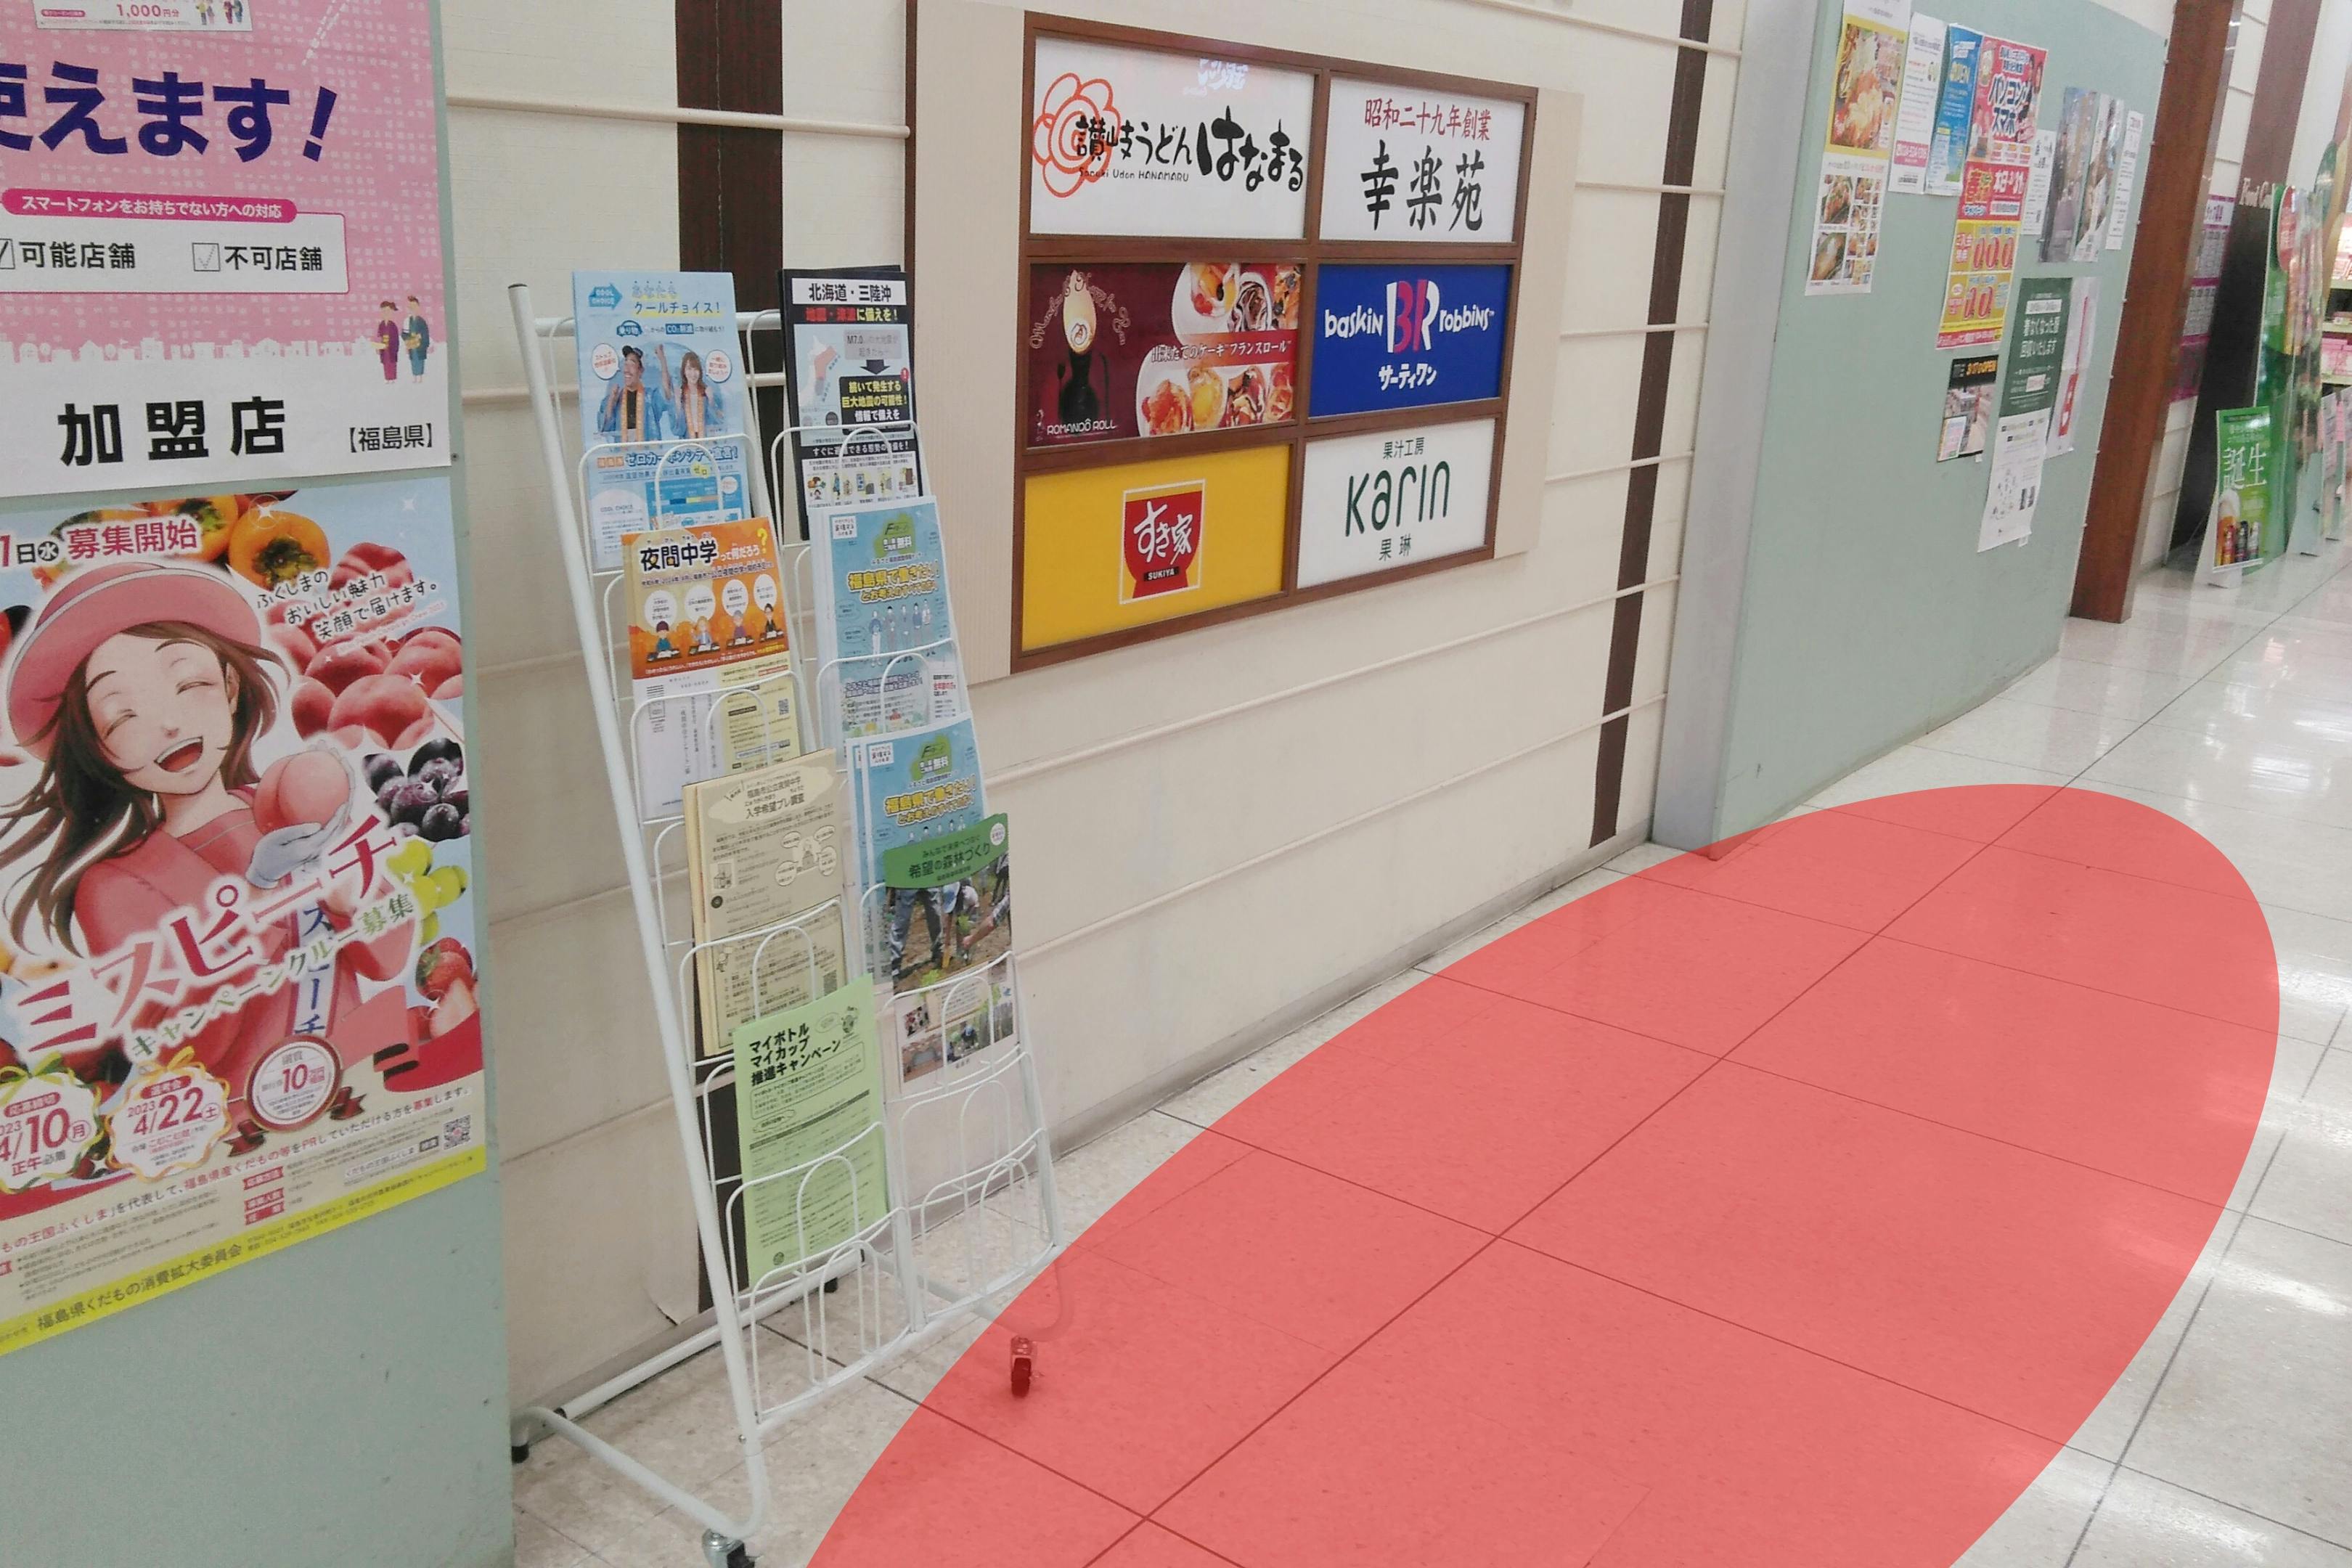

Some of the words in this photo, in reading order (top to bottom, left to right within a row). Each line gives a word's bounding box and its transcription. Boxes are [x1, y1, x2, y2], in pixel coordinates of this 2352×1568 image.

[1365, 97, 1493, 142] 昭和二十九年創業
[1075, 115, 1193, 166] 讃岐うどん
[1196, 105, 1304, 192] はなまる
[1112, 168, 1135, 179] Udon
[1138, 171, 1189, 181] HANAMARU
[1360, 139, 1485, 232] 幸楽苑
[21, 196, 282, 219] スマートフォンをお持ちでない方への対応
[18, 242, 136, 269] 可能店舗
[224, 248, 323, 271] 不可店舗
[634, 301, 721, 314] クールチョイス!
[808, 283, 891, 303] 北海道・三陸沖
[1324, 299, 1384, 338] baskin
[1439, 300, 1490, 334] robbins
[1379, 362, 1438, 391] サーティワン
[57, 396, 286, 467] 加盟店
[348, 423, 433, 453] 【福島県】
[1094, 418, 1117, 430] ROLL
[1383, 437, 1425, 461] 果汁工房
[2222, 442, 2267, 490] 誕生
[67, 518, 198, 560] 募集開始
[1134, 500, 1193, 565] すき家
[1379, 534, 1412, 562] 果琳
[640, 539, 718, 571] 夜間中学
[257, 571, 327, 609] ふくしまの
[1147, 568, 1175, 581] SUKIYA
[287, 573, 385, 625] おいしい魅力
[315, 579, 436, 639] 笑顔で届けます。
[18, 814, 397, 1052] ミスピーチ
[131, 894, 414, 1057] キャンペーンクルー募集
[749, 1023, 809, 1053] マイボトル
[751, 1035, 810, 1068] マイカップ
[282, 1063, 308, 1093] 10
[751, 1040, 841, 1087] 推進キャンペーン
[127, 1101, 155, 1117] 2023
